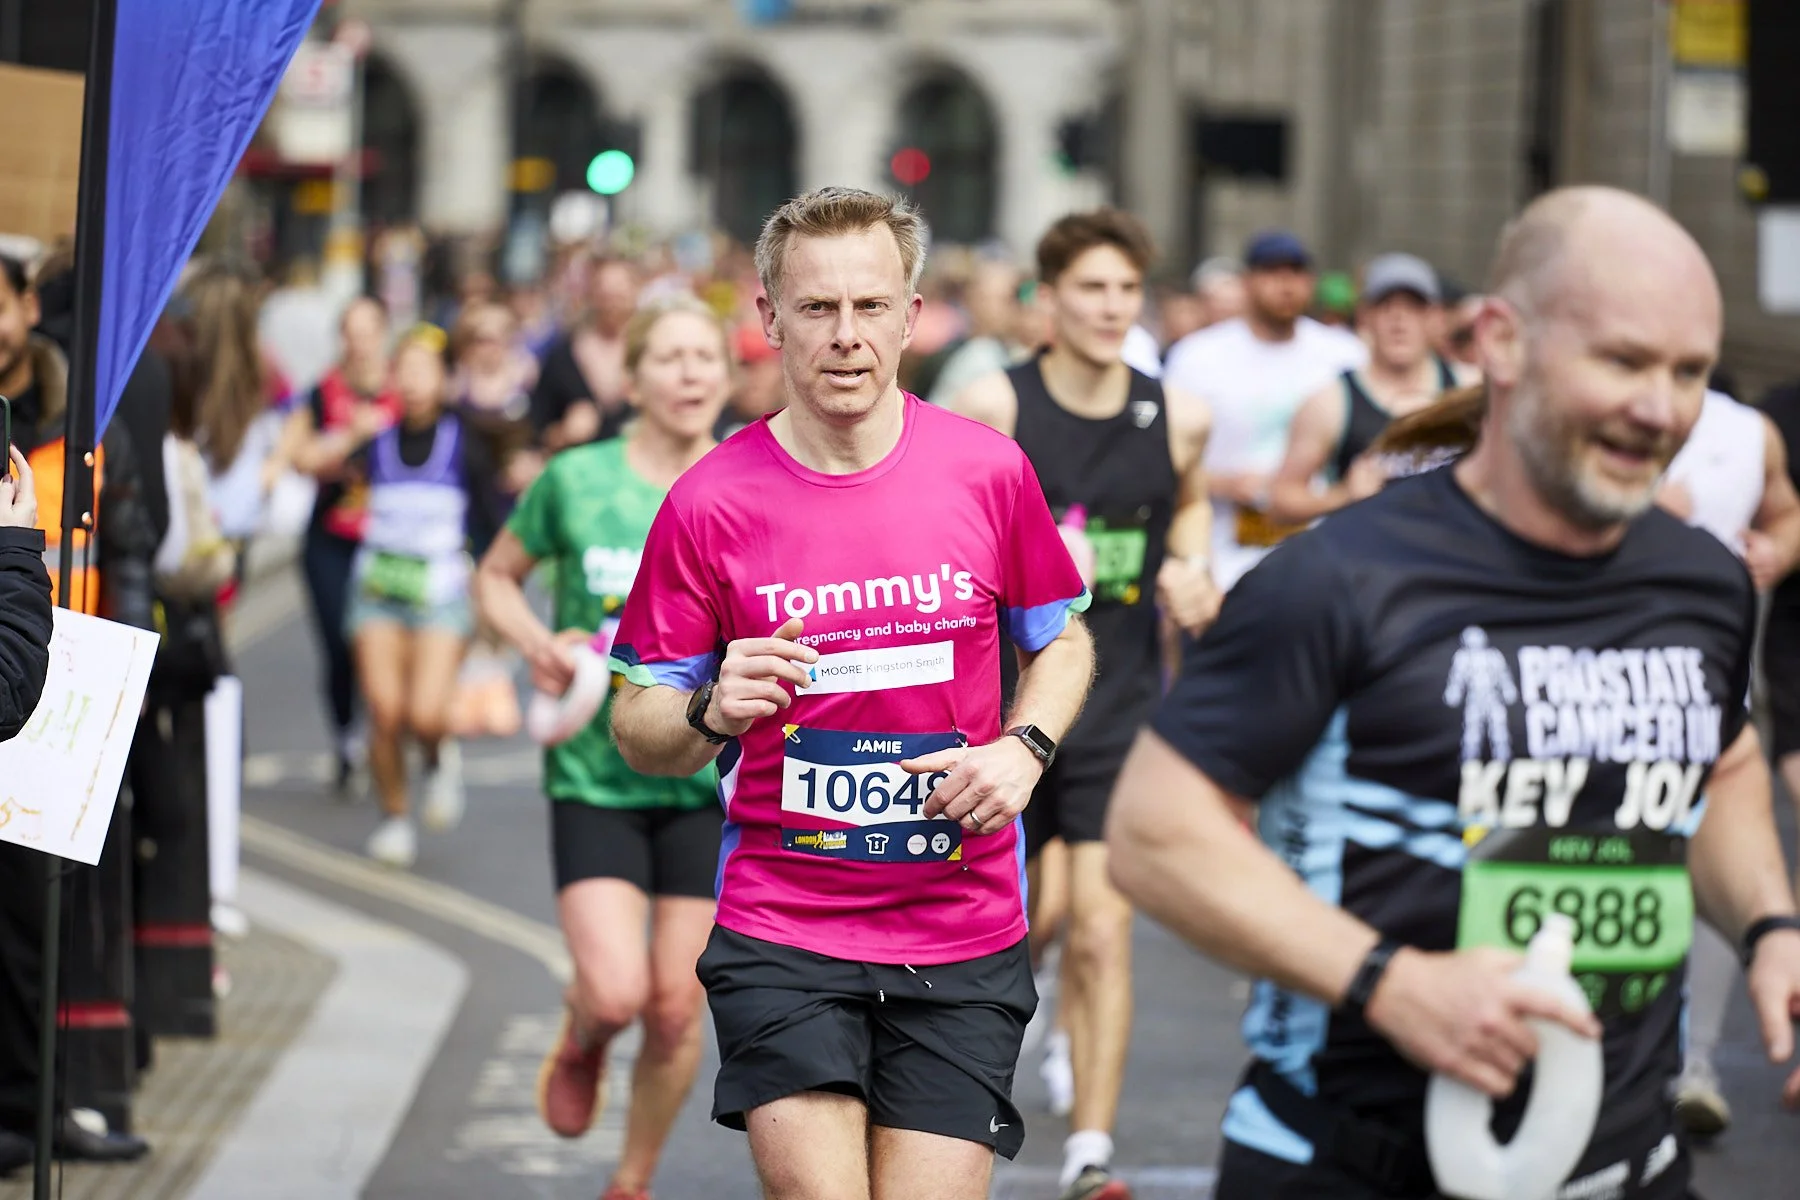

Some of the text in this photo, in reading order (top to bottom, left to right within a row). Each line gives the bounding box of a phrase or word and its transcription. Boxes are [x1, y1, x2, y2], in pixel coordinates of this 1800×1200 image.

[756, 564, 974, 622] Tommy's
[793, 614, 977, 646] regnancy and baby charity
[821, 655, 945, 677] MOORE Kingston Smith
[1517, 645, 1711, 706] PROSTATE
[852, 739, 903, 754] JAMIE
[1525, 701, 1685, 764] CANCER
[1457, 758, 1590, 827] KEV
[937, 842, 944, 850] 4
[1504, 885, 1661, 949] 6888
